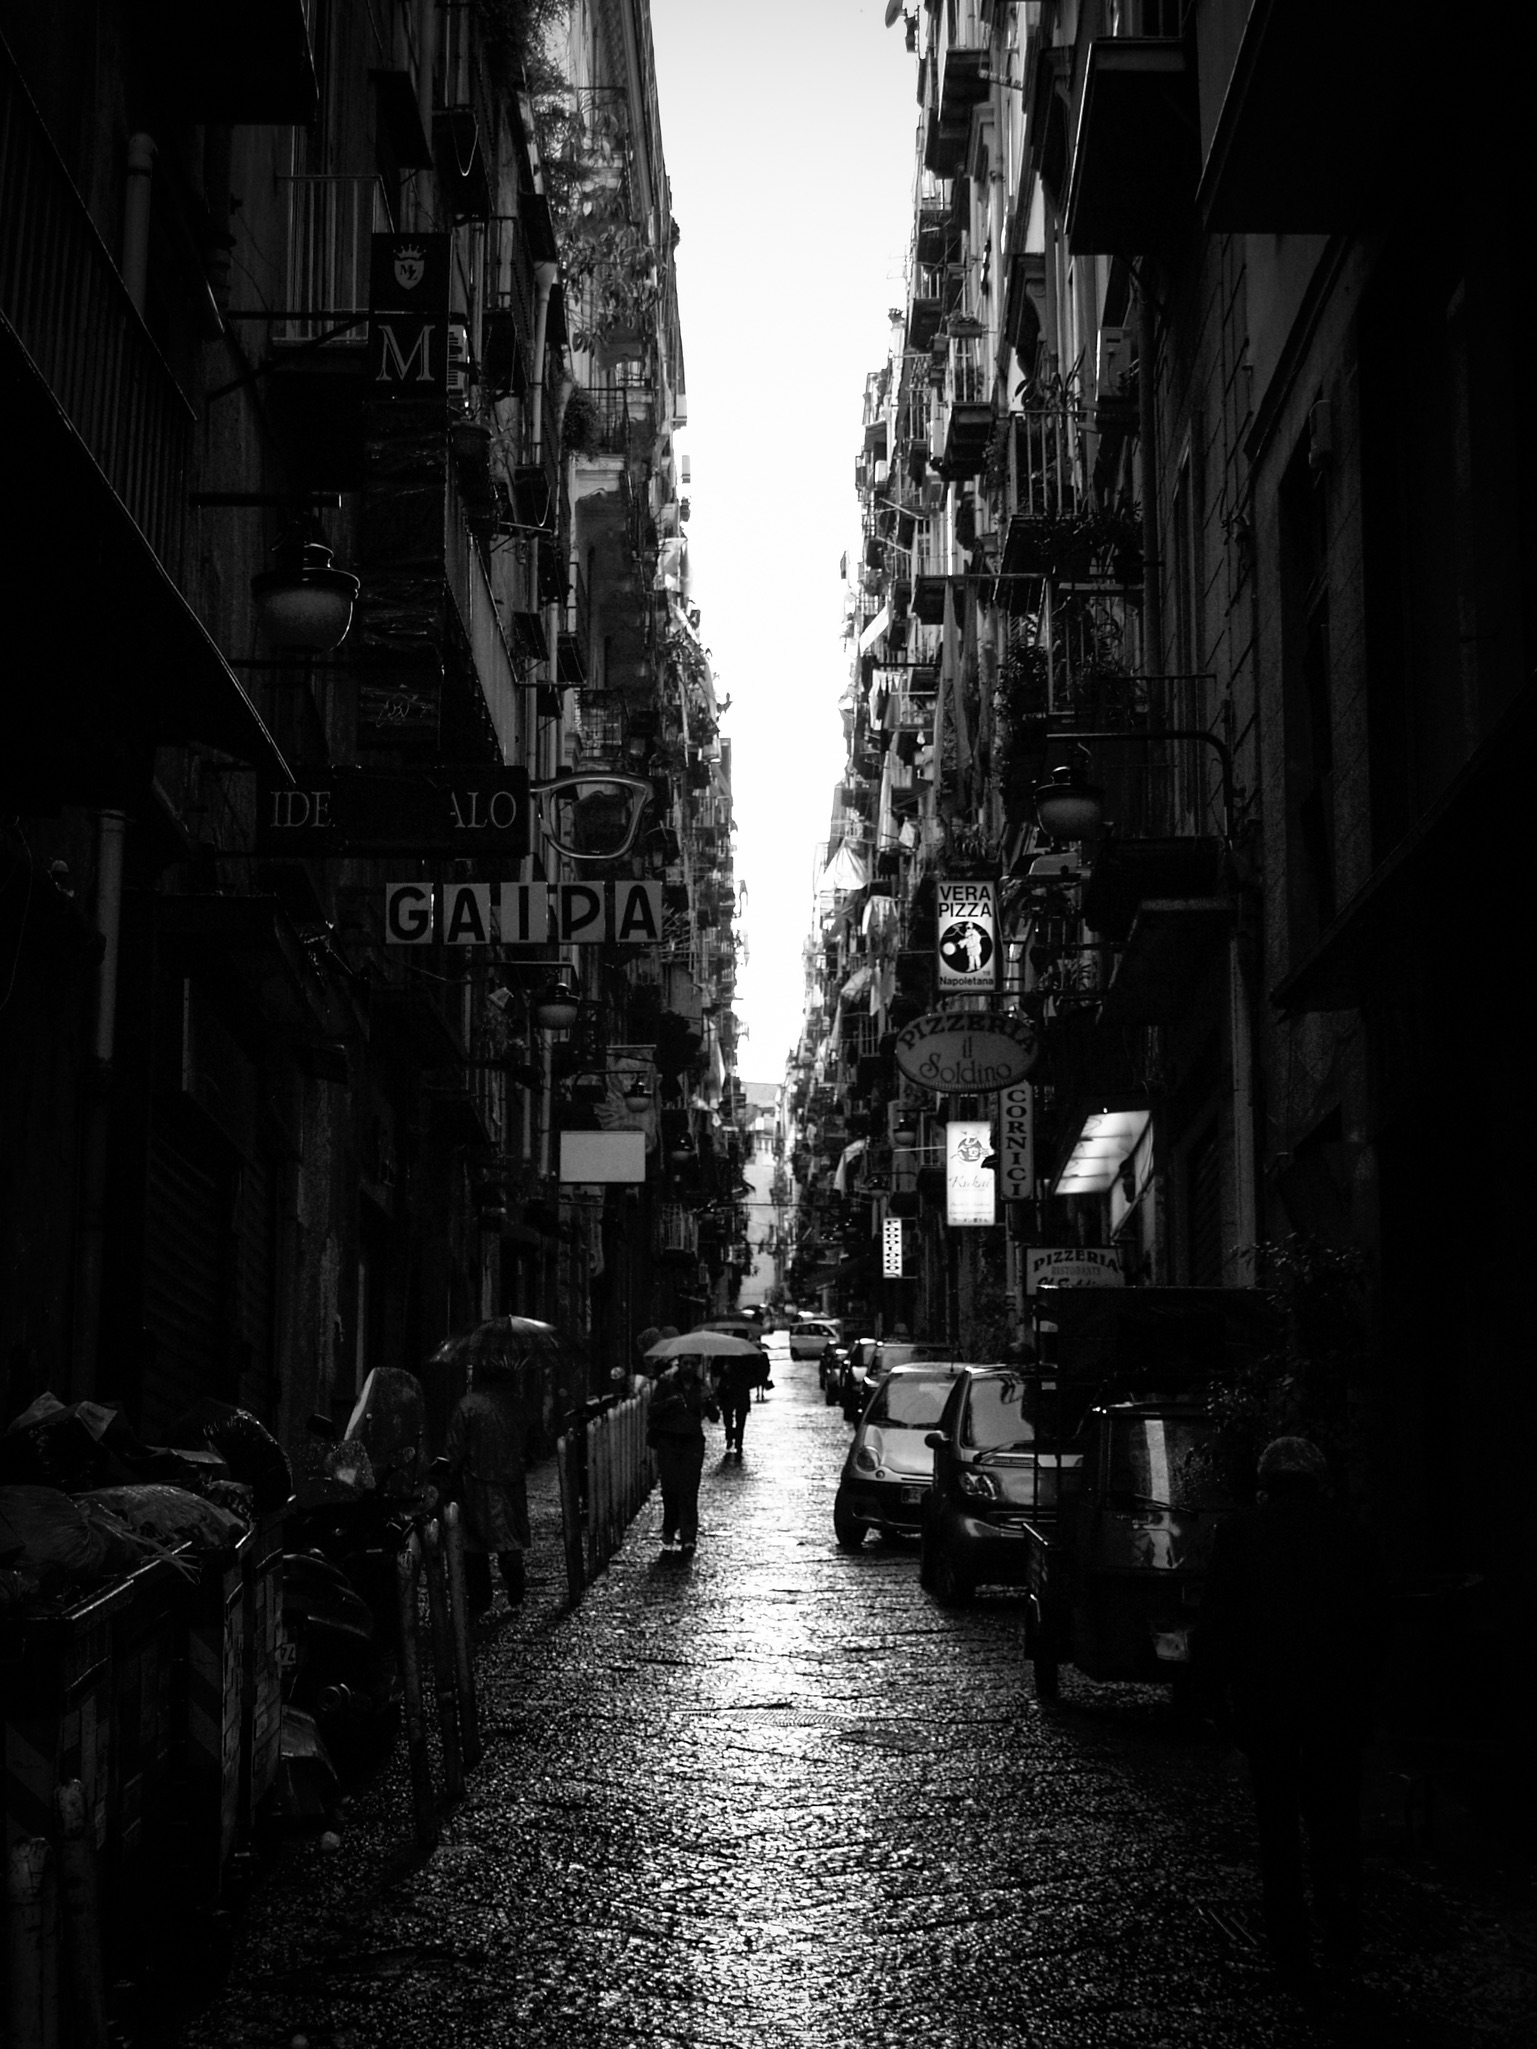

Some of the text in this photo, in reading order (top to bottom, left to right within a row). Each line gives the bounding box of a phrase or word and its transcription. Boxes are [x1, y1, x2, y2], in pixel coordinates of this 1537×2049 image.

[375, 324, 436, 382] M
[270, 790, 518, 829] IDE ALO
[938, 903, 992, 917] PIZZA
[940, 886, 991, 901] VERA
[389, 884, 659, 942] GAIPA
[939, 977, 994, 987] Napoletana
[899, 1014, 1036, 1056] PIZZERIA
[919, 1053, 1012, 1084] Soldino
[1006, 1089, 1027, 1197] CORNICI
[1034, 1250, 1119, 1274] PIZZERIA
